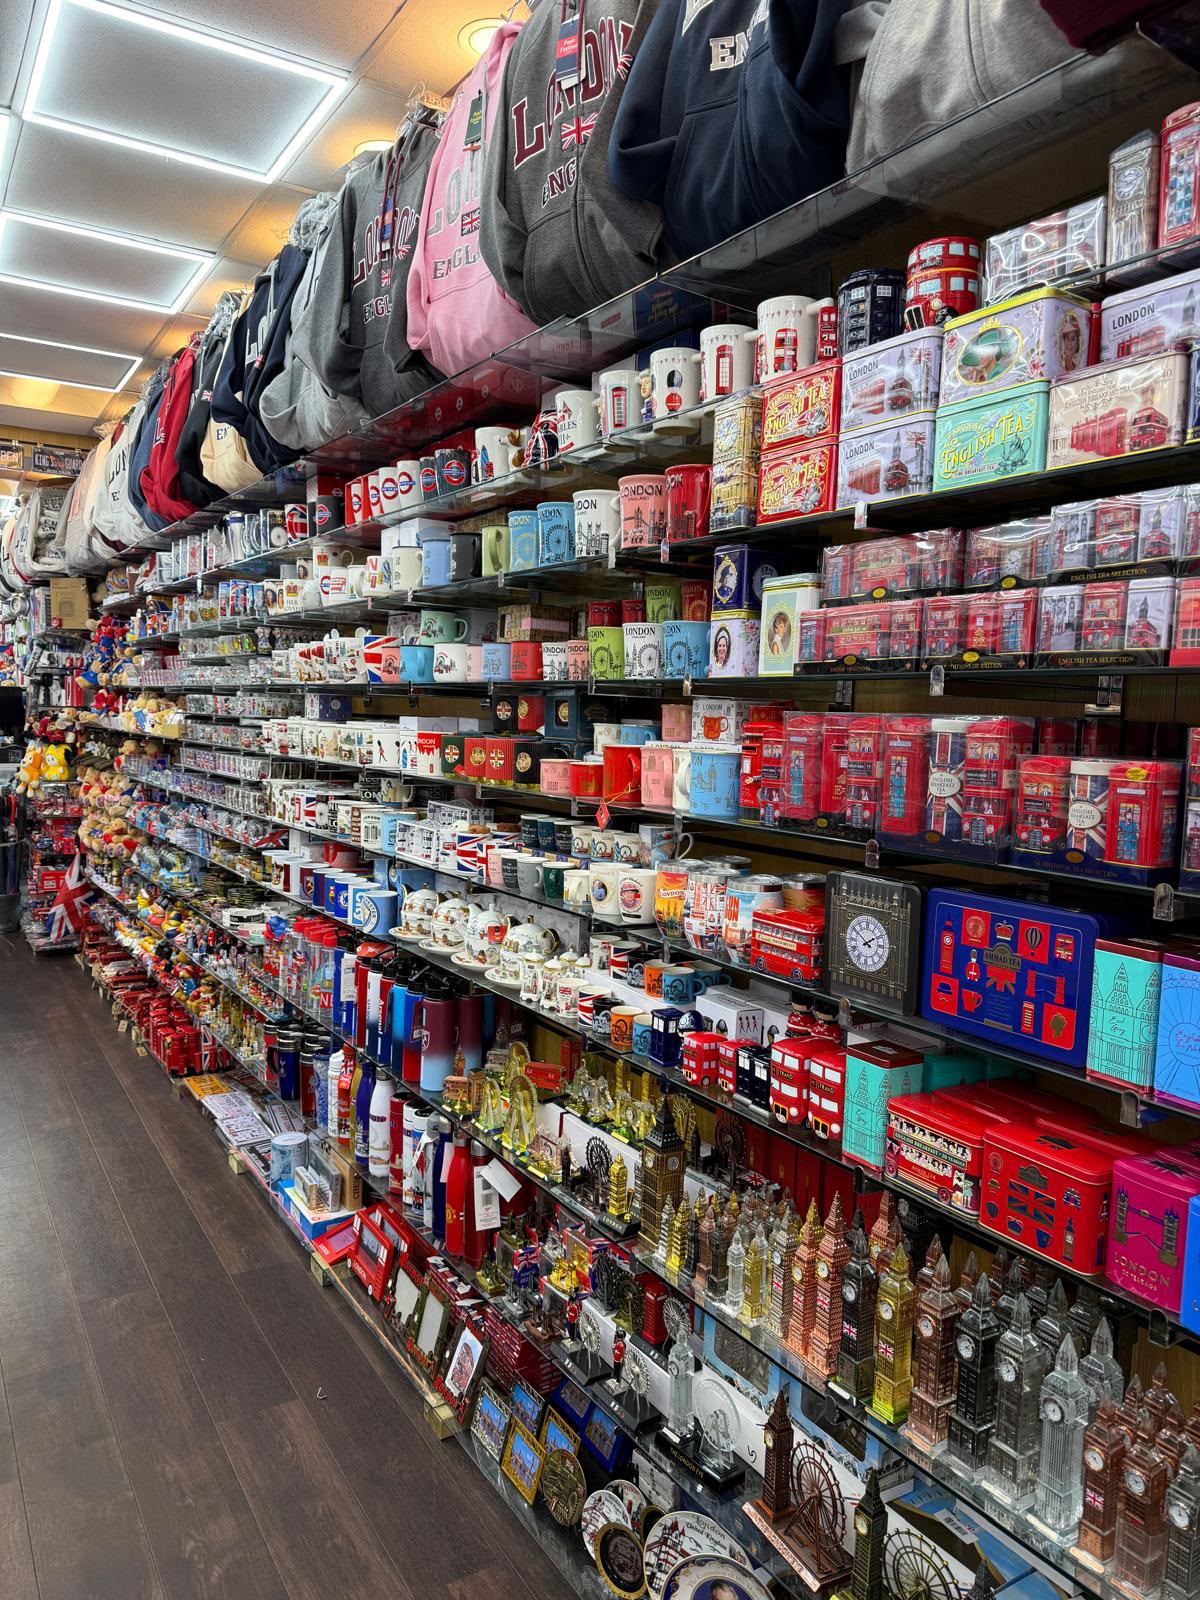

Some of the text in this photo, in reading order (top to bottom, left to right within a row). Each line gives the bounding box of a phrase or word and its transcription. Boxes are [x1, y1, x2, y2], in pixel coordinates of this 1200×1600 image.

[1112, 303, 1156, 331] LONDON
[849, 360, 879, 381] LONDON
[766, 385, 825, 440] ENGLISH TEA
[845, 440, 875, 460] LONDON
[941, 412, 1024, 478] ENGLISH TEA
[763, 462, 819, 510] ENGLISH TEA
[1110, 567, 1147, 578] SELECTION
[625, 627, 656, 636] LONDON
[1097, 656, 1134, 664] SELECTION
[661, 889, 685, 897] LONDON
[726, 895, 739, 909] LON
[985, 951, 1009, 963] AHMAD
[1009, 956, 1021, 969] TEA
[1108, 1016, 1125, 1025] Earl
[1111, 1024, 1127, 1036] Grey
[817, 1081, 835, 1095] STRAND
[895, 1131, 914, 1145] ENGLISH
[914, 1139, 939, 1157] BREAKFAST
[941, 1151, 948, 1160] 20
[353, 1259, 366, 1281] LONDON
[1114, 1252, 1170, 1287] LONDON
[670, 1447, 704, 1479] THE LONDON EYE
[686, 1522, 704, 1537] United
[696, 1514, 727, 1540] London
